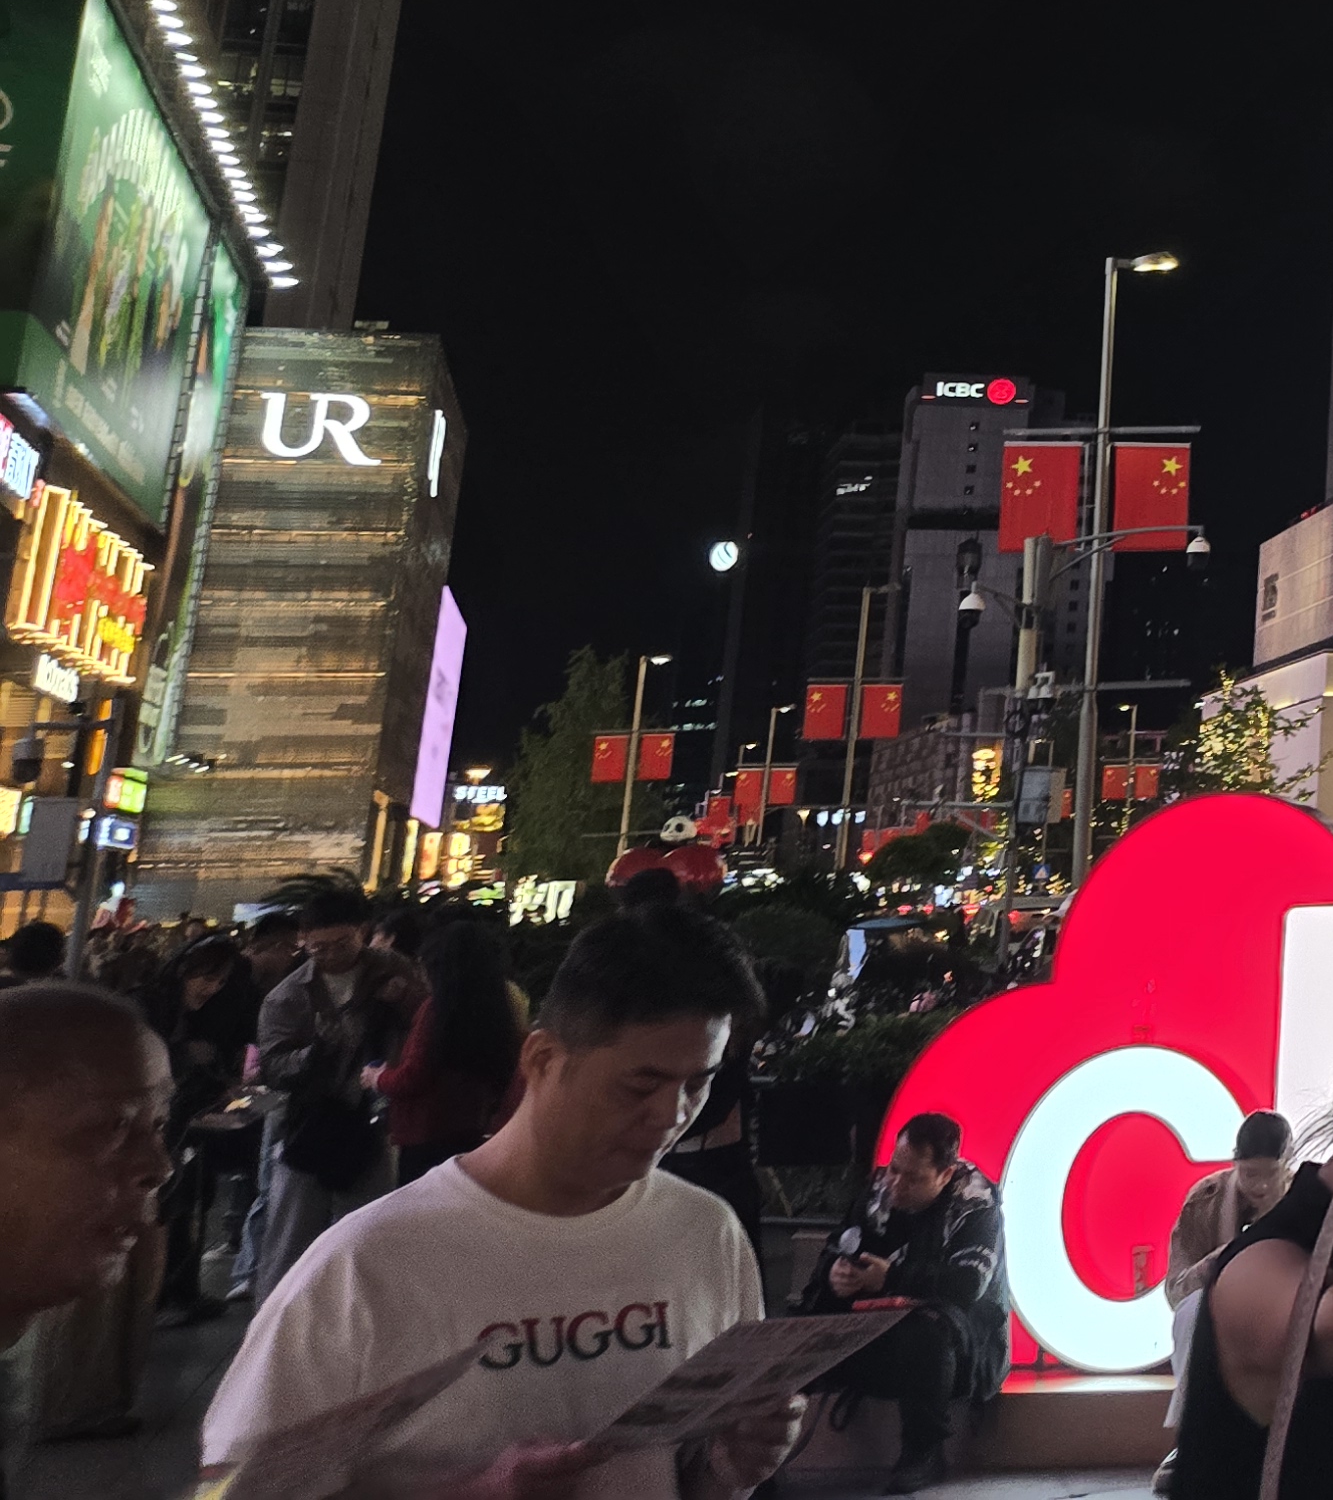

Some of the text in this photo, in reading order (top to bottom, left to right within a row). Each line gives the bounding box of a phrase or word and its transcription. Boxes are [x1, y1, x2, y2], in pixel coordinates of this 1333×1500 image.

[936, 381, 986, 398] ICBC
[259, 392, 382, 466] UR
[477, 1299, 672, 1370] GUGGI
